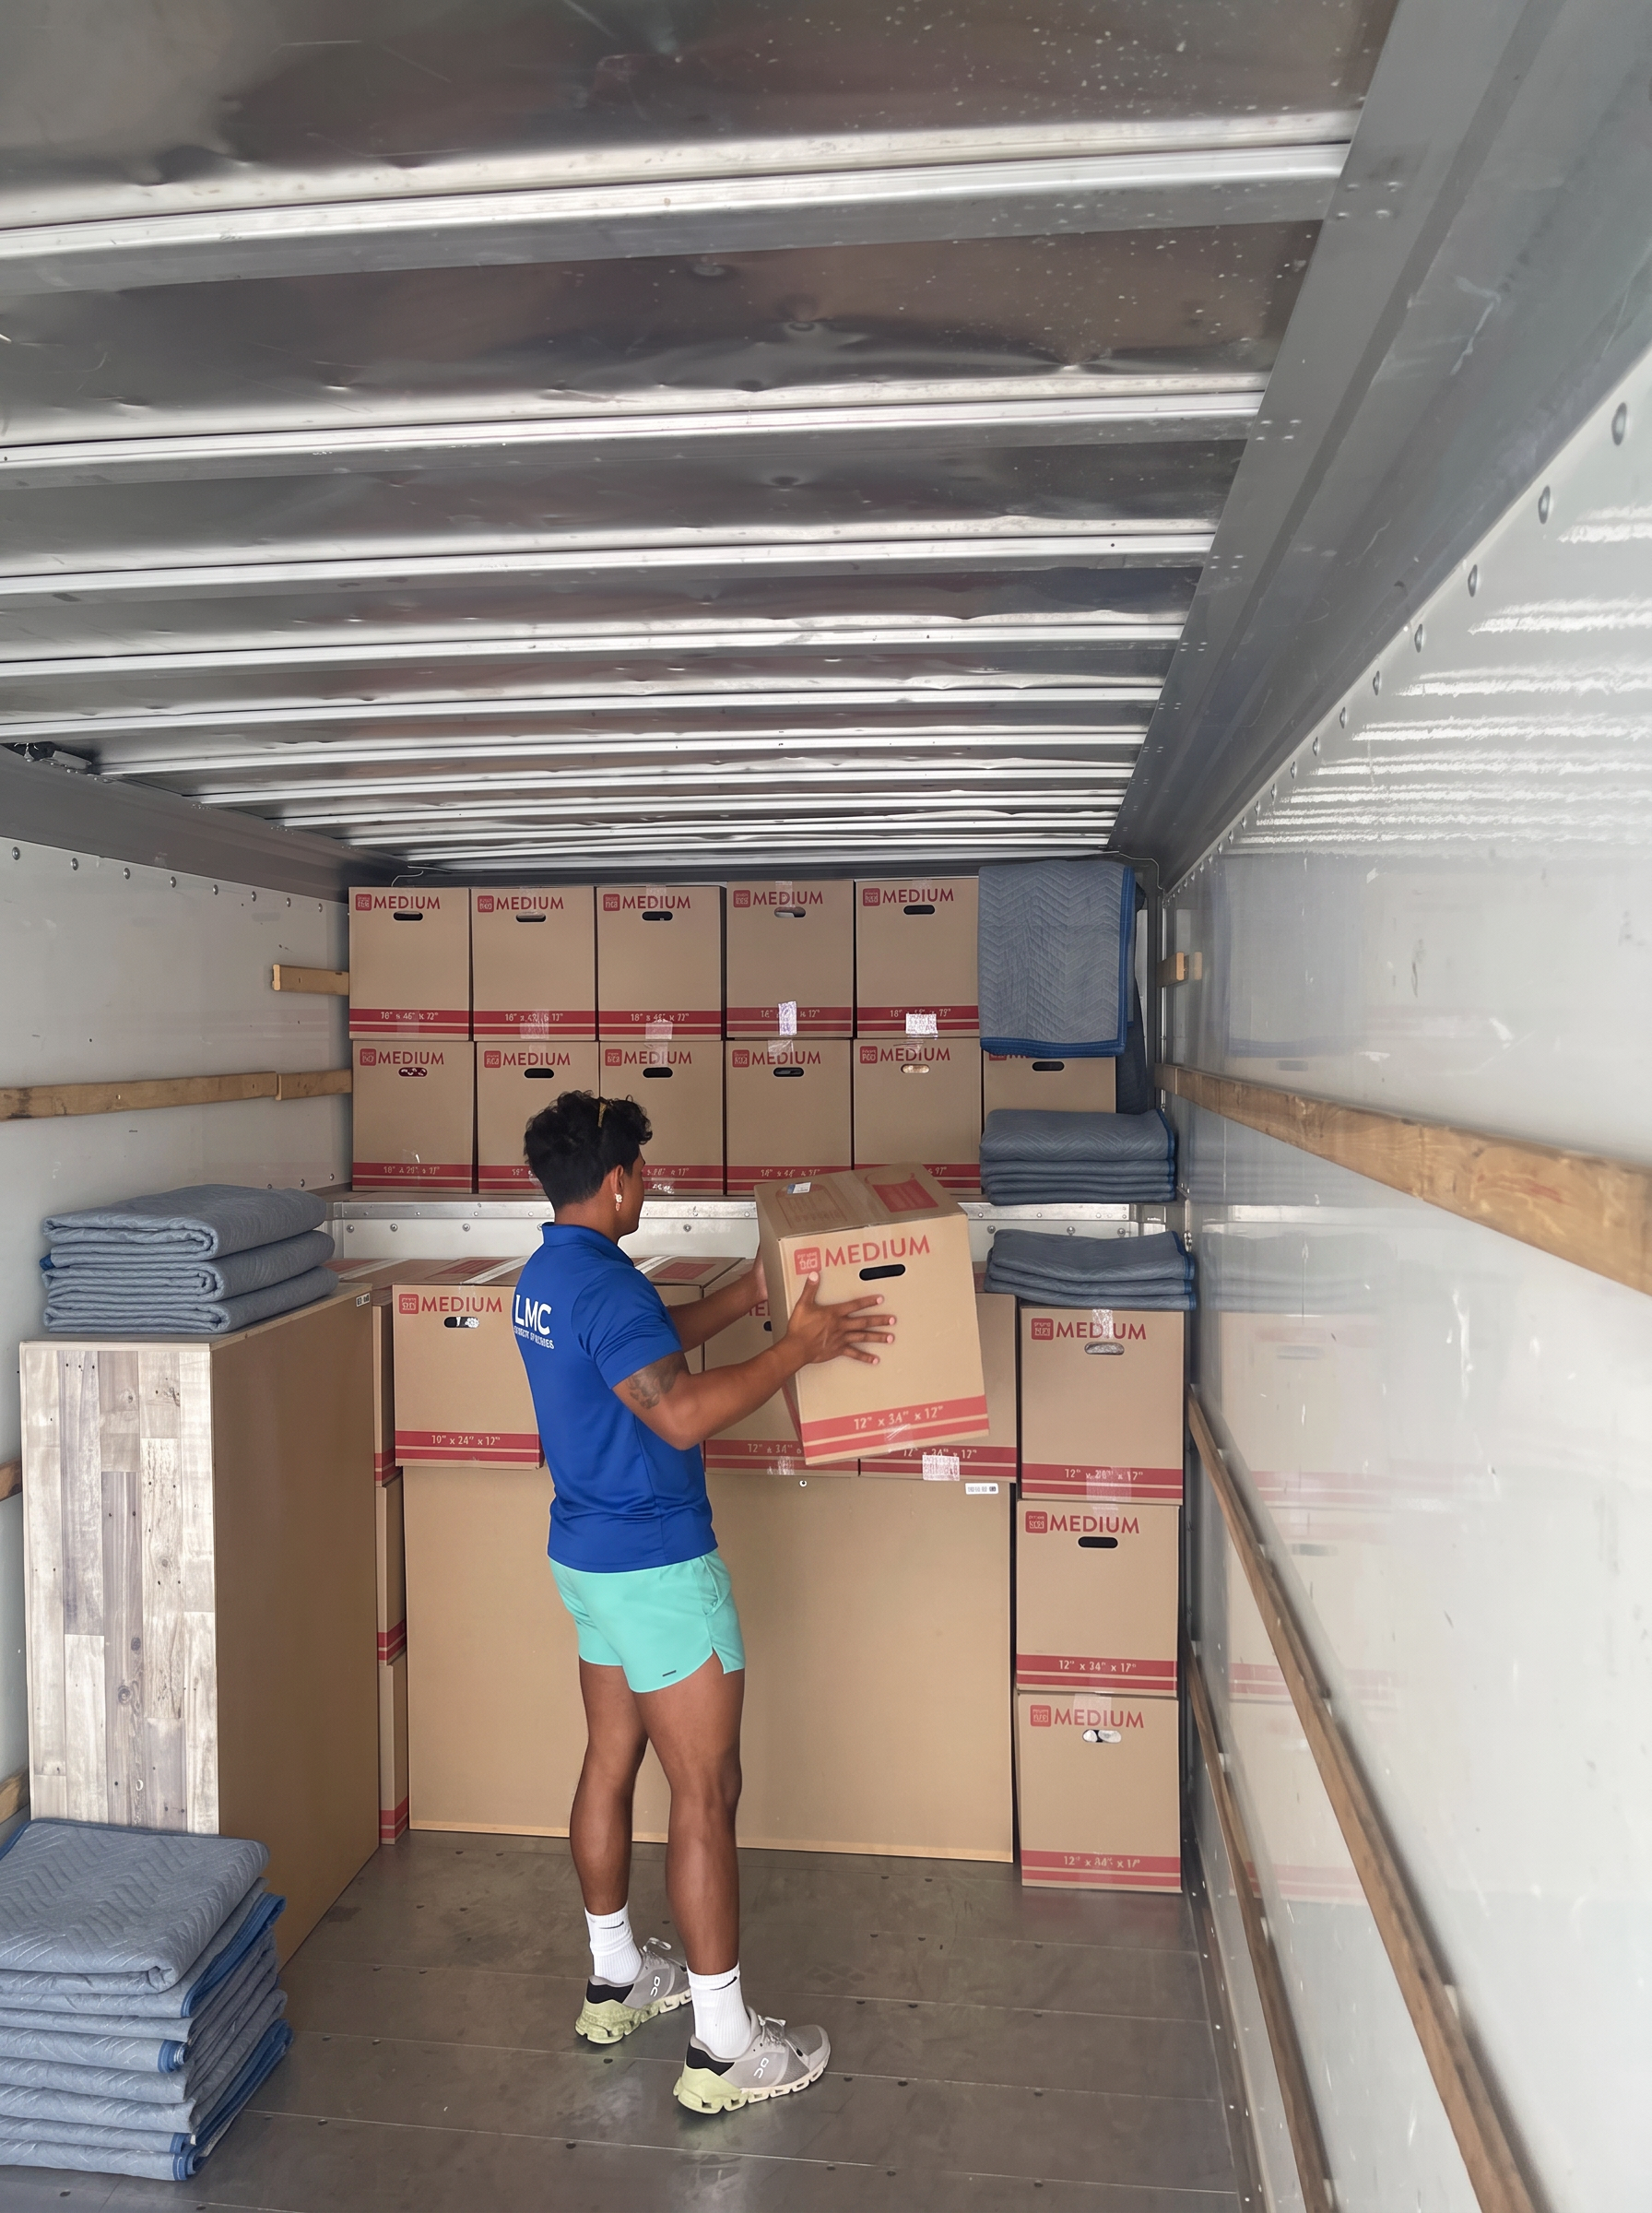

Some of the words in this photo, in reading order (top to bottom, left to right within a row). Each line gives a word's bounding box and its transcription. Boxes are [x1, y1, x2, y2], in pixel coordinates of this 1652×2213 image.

[373, 896, 440, 909] MEDIUM
[622, 896, 690, 909] MEDIUM
[753, 891, 823, 905] MEDIUM
[882, 888, 953, 903] MEDIUM
[496, 896, 563, 910] MEDIUM
[378, 1051, 444, 1065] MEDIUM
[502, 1052, 571, 1066] MEDIUM
[624, 1051, 692, 1065] MEDIUM
[752, 1050, 821, 1065] MEDIUM
[880, 1047, 950, 1061] MEDIUM
[825, 1235, 930, 1268] MEDIUM
[421, 1296, 502, 1313] MEDIUM
[514, 1294, 552, 1336] LMC
[1050, 1514, 1140, 1534] MEDIUM
[1111, 1664, 1117, 1673] x
[1054, 1708, 1144, 1729] MEDIUM
